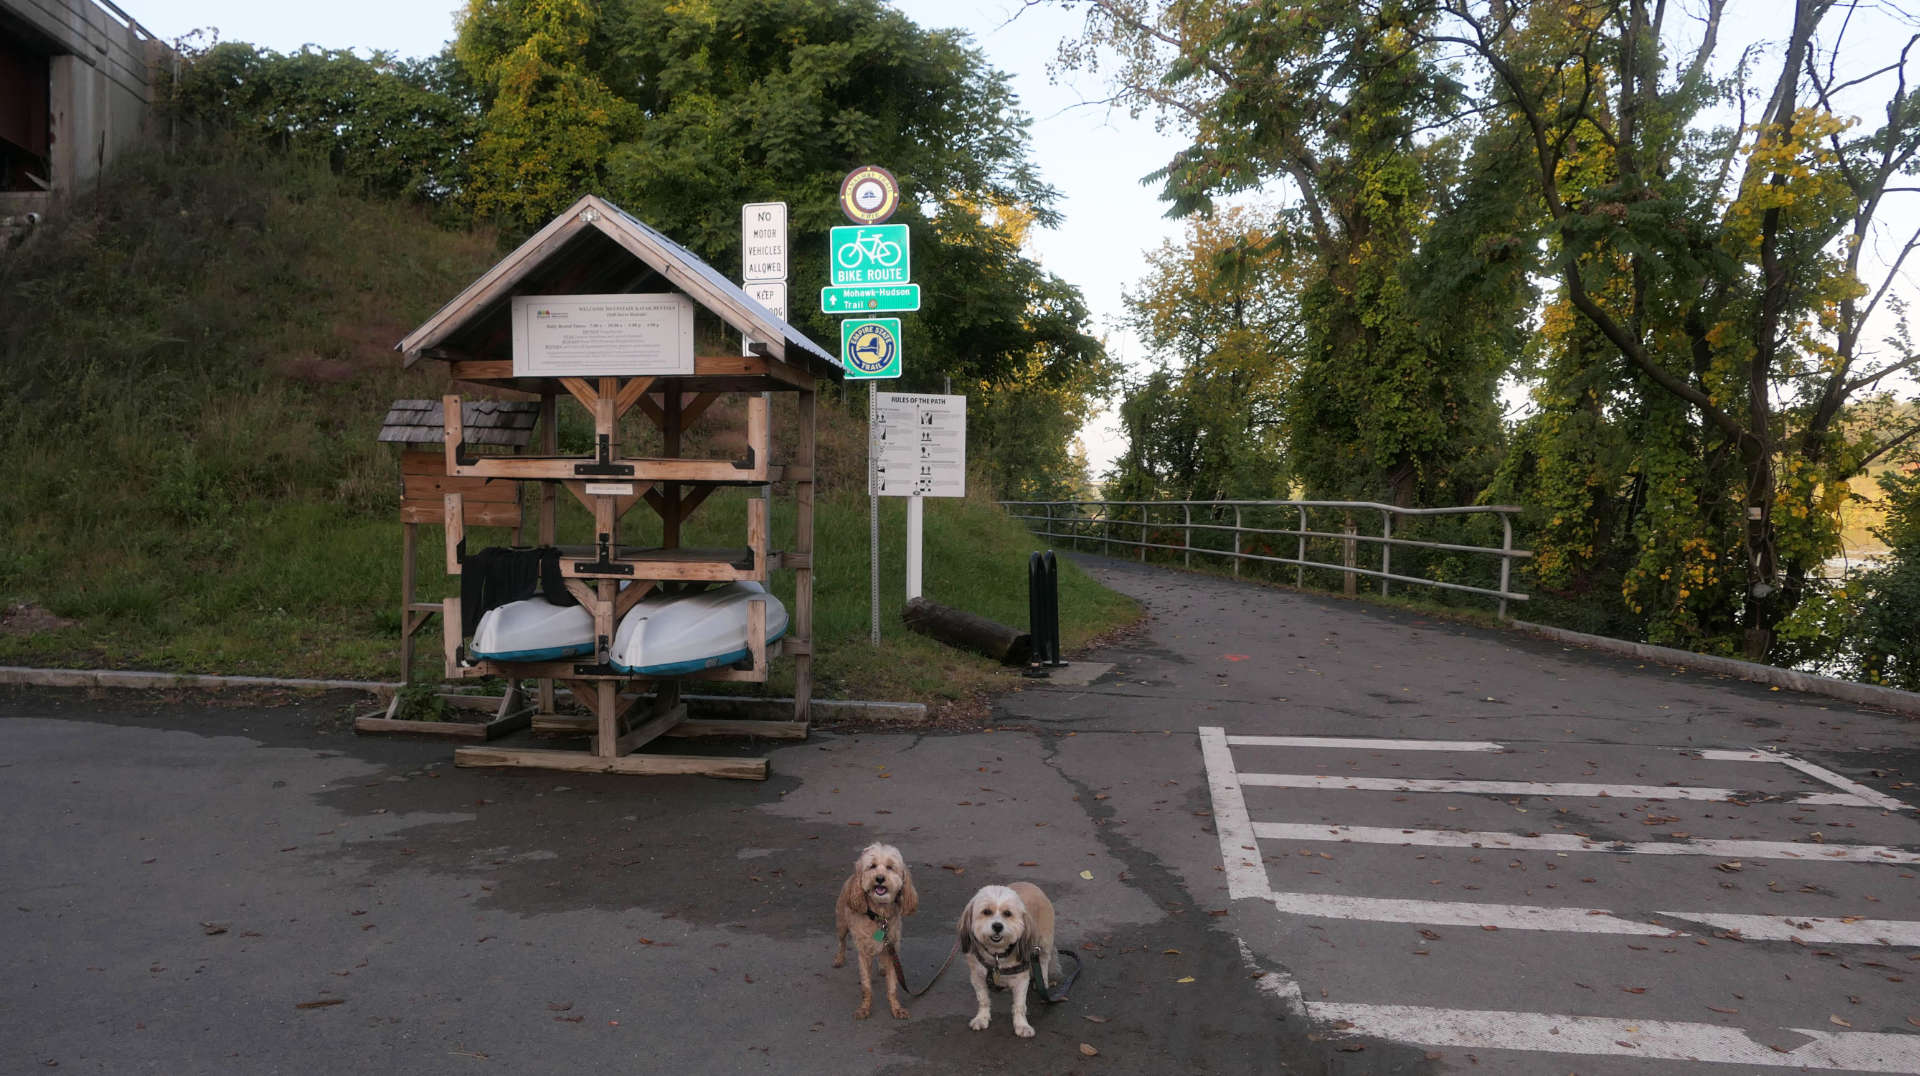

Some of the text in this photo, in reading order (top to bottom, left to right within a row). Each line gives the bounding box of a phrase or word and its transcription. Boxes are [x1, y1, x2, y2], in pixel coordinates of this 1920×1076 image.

[758, 211, 771, 222] NO
[753, 229, 777, 238] MOTOR
[748, 246, 782, 256] VEHICLES
[748, 263, 782, 273] ALLOWED
[838, 267, 903, 282] BIKE ROUTE
[756, 290, 774, 300] KEEP
[843, 288, 911, 297] Mohawk-Hudson
[843, 300, 864, 309] Trail
[850, 326, 892, 345] EMPIRE STATE
[861, 361, 882, 370] TRAIL
